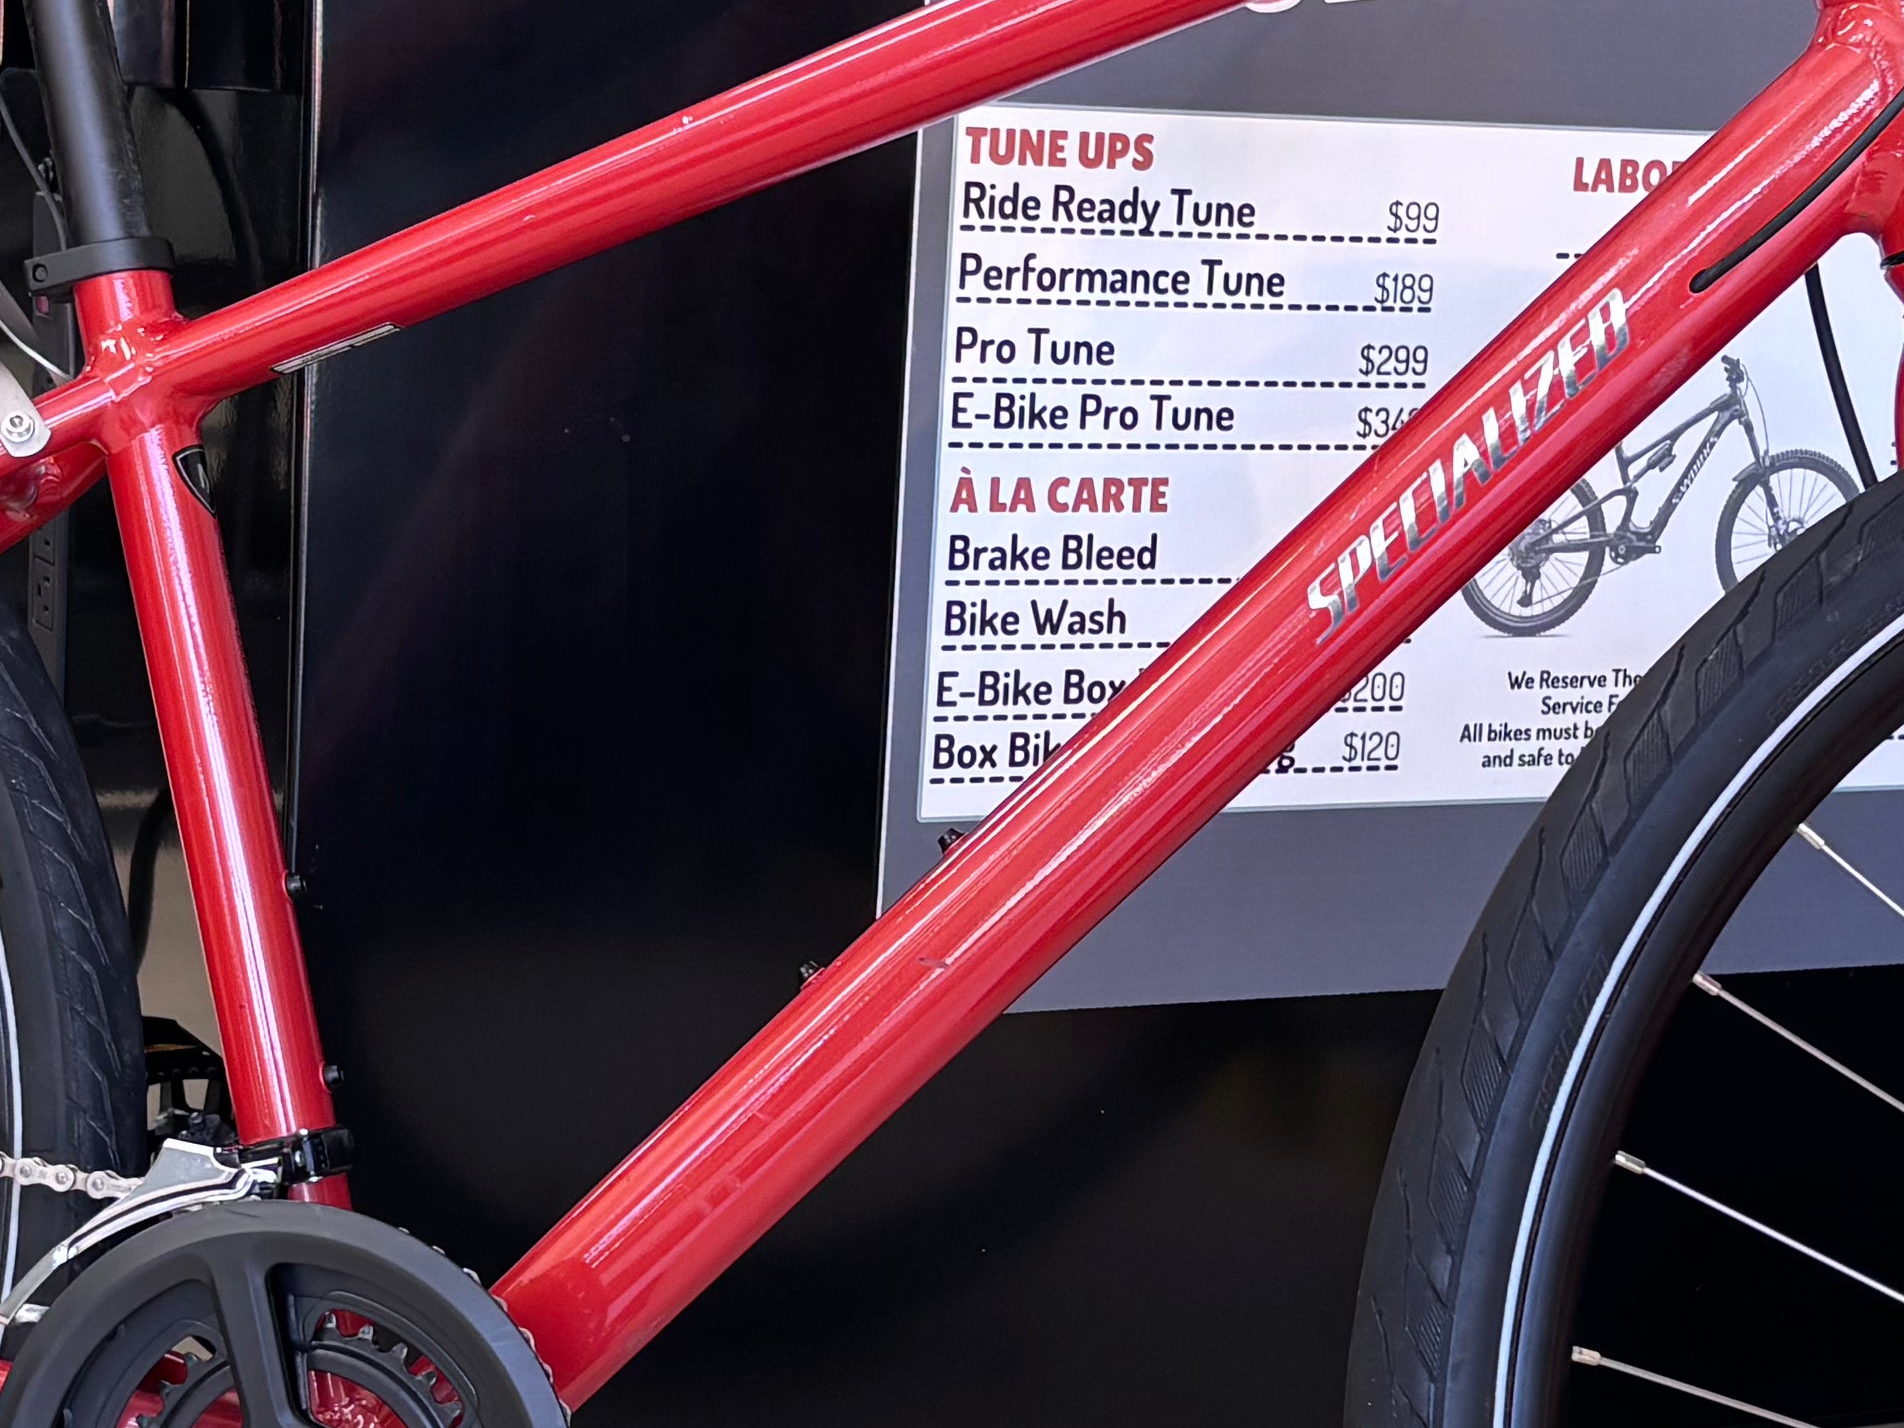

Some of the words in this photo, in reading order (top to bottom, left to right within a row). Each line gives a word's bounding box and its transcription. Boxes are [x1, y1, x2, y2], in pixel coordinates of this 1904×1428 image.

[966, 127, 1067, 168] TUNE
[1079, 132, 1154, 170] UPS
[1573, 157, 1684, 193] LABO
[963, 181, 1041, 222] Ride
[1052, 185, 1161, 234] Ready
[1170, 188, 1255, 228] Tune
[1387, 201, 1440, 234] $99
[959, 253, 1190, 296] Performance
[1201, 259, 1285, 297] Tune
[1374, 273, 1433, 306] $189
[955, 327, 1015, 364] Pro
[1027, 328, 1114, 366] Tune
[1359, 343, 1428, 377] $299
[951, 392, 1068, 430] E-Bike
[1080, 394, 1138, 431] Pro
[1150, 395, 1234, 431] Tune
[1307, 288, 1630, 645] SPECIALIZED
[950, 467, 978, 513] À
[989, 477, 1036, 513] LA
[1048, 476, 1169, 514] CARTE
[948, 534, 1050, 571] Brake
[1062, 533, 1157, 572] Bleed
[944, 600, 1020, 636] Bike
[1031, 597, 1126, 636] Wash
[937, 669, 1052, 707] E-Bike
[1063, 669, 1126, 704] Box
[1508, 671, 1534, 690] We
[1539, 670, 1606, 689] Reserve
[1541, 696, 1603, 715] Service
[933, 734, 997, 769] Box
[1009, 730, 1061, 767] Bik
[1342, 731, 1400, 763] $120
[1460, 723, 1483, 743] All
[1487, 722, 1531, 742] bikes
[1536, 722, 1579, 741] must
[1482, 748, 1514, 768] and
[1518, 747, 1553, 767] safe
[1558, 748, 1576, 766] to
